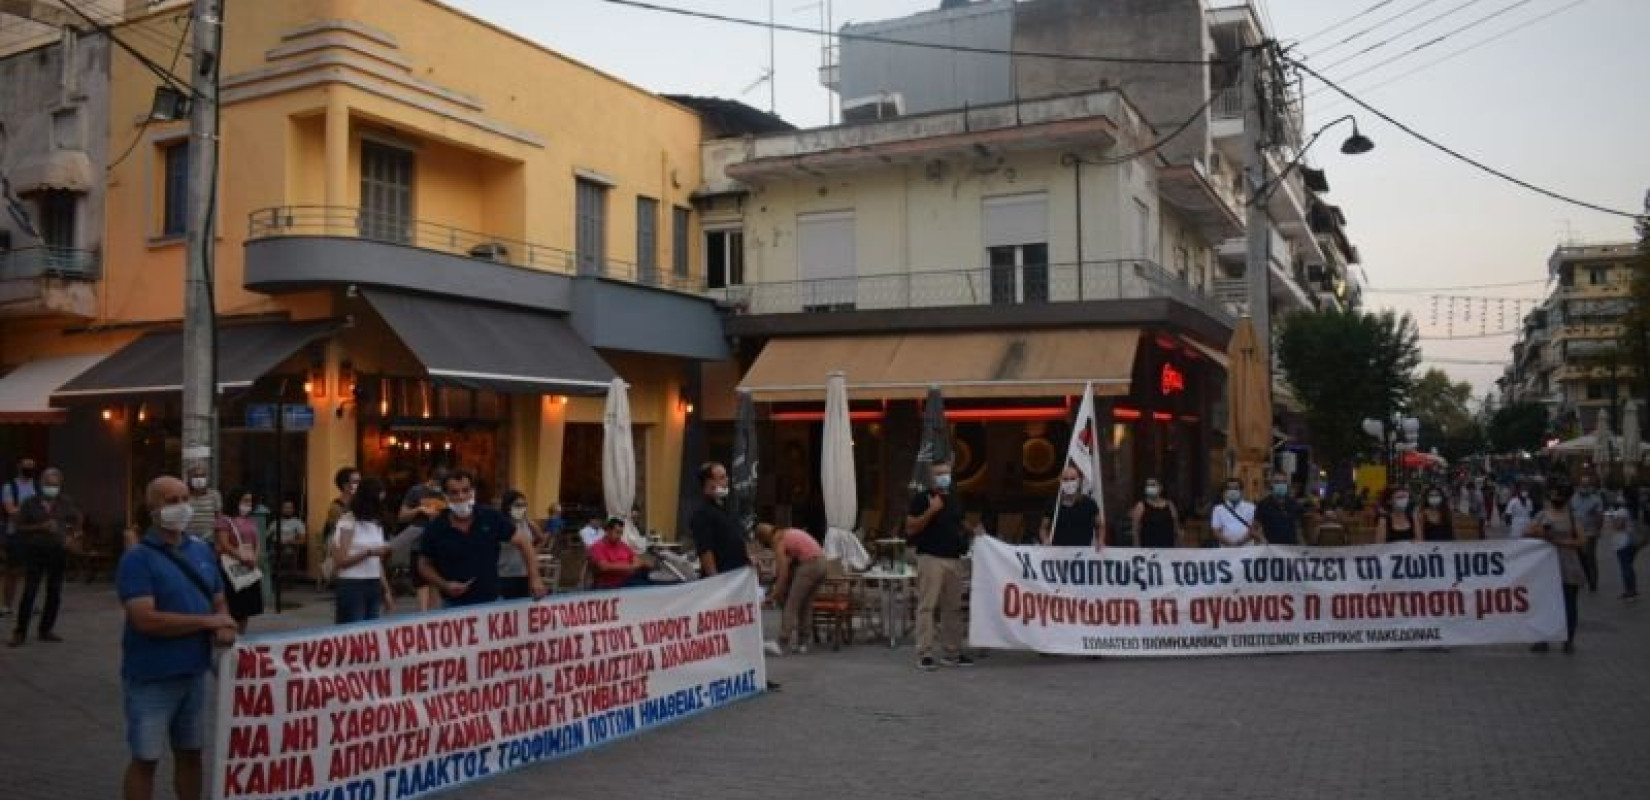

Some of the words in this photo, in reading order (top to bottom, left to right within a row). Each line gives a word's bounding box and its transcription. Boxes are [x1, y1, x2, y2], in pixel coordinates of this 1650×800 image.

[1004, 582, 1140, 627] Οργάνωση
[1151, 596, 1179, 626] κι
[1190, 588, 1294, 629] αγώνας
[1304, 593, 1321, 621] η
[1331, 583, 1465, 621] απάντησή
[1475, 585, 1529, 620] μας
[1041, 552, 1163, 591] ανάπτυξή
[1172, 559, 1233, 586] τους
[1241, 551, 1347, 583] τσακίζει
[1354, 554, 1383, 580] τη
[1390, 546, 1444, 580] ζωή
[1454, 551, 1505, 584] μας
[233, 682, 275, 718] ΝΑ
[286, 667, 393, 714] ΠΑΡΘΟΥΝ
[401, 656, 468, 693] ΜΕΤΡΑ
[477, 634, 584, 681] ΠΡΟΣΤΑΣΙΑΣ
[591, 626, 638, 656] ΣΤΟΥΣ
[640, 615, 692, 646] ΧΩΡΟΥΣ
[697, 603, 756, 635] ΔΟΥΛΕΙΑΣ
[235, 644, 277, 679] ΜΕ
[282, 630, 381, 673] ΕΥΘΥΝΗ
[386, 616, 479, 660] ΚΡΑΤΟΥΣ
[487, 609, 519, 642] ΚΑΙ
[527, 598, 621, 634] ΕΡΓΟΔΟΣΙΑΣ
[224, 754, 315, 798] ΚΑΜΙΑ
[328, 727, 431, 782] ΑΠΟΛΥΣΗ
[436, 714, 496, 754] ΚΑΜΙΑ
[500, 695, 567, 739] ΑΛΛΑΓΗ
[571, 675, 649, 720] ΣΥΜΒΑΣΗΣ
[228, 724, 271, 760] ΝΑ
[280, 714, 319, 753] ΜΗ
[329, 699, 419, 745] ΧΑΘΟΥΝ
[384, 745, 493, 800] ΓΑΛΑΚΤΟΣ
[497, 721, 585, 771] ΤΡΟΦΙΜΩΝ
[587, 705, 636, 745] ΠΟΤΩΝ
[639, 669, 756, 726] ΗΜΑΘΕΙΑΣ-ΠΕΛΛΑΣ
